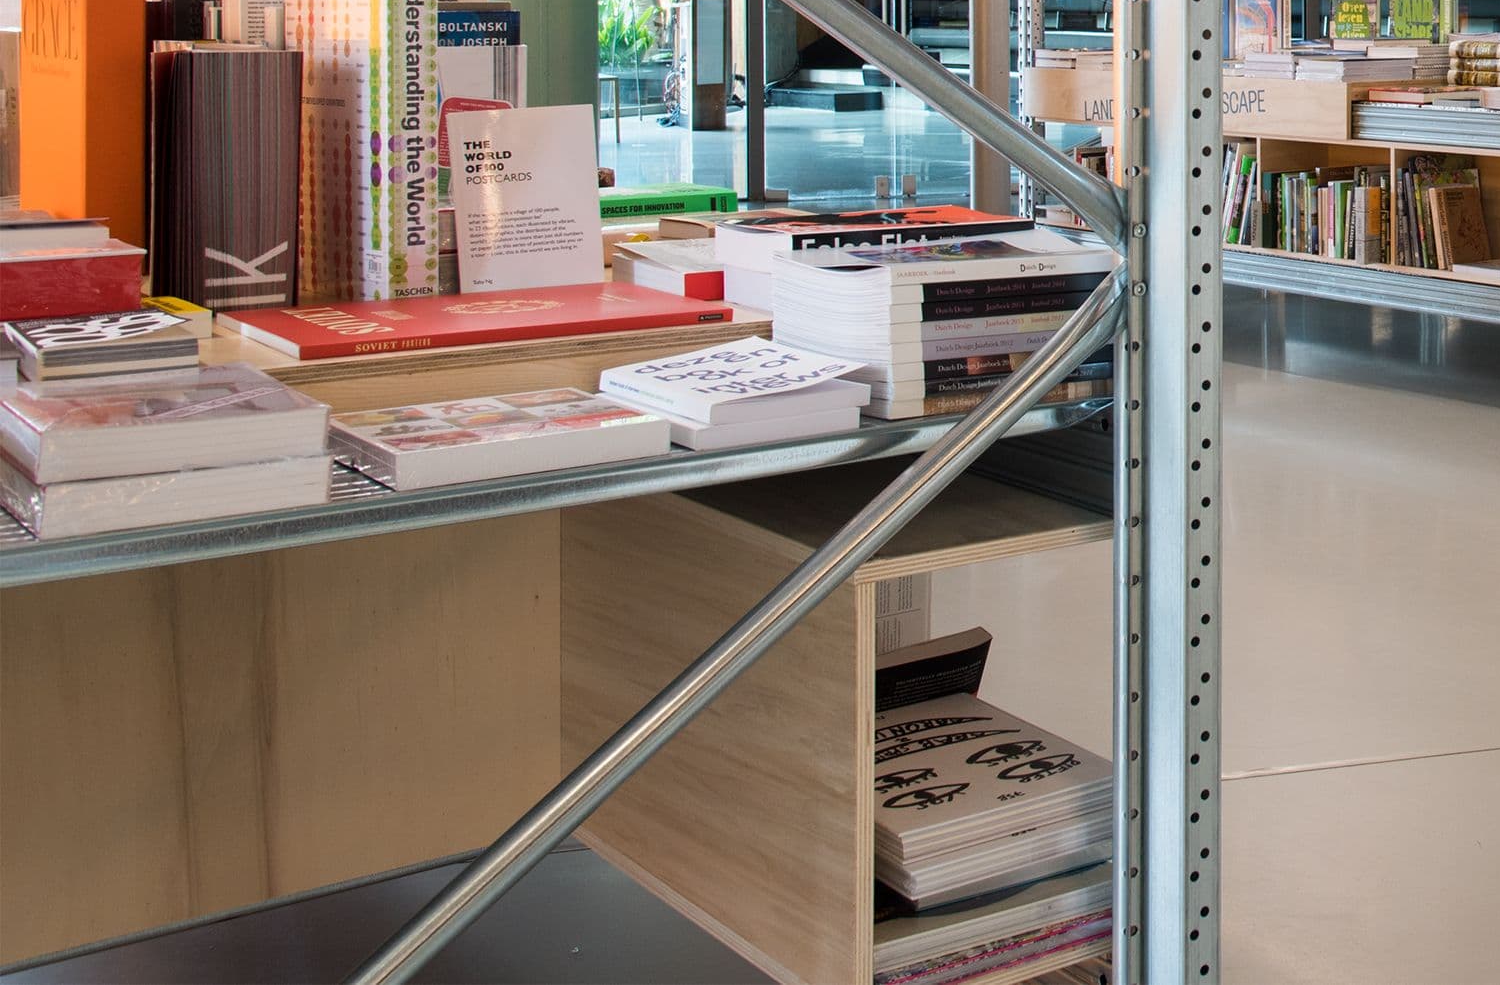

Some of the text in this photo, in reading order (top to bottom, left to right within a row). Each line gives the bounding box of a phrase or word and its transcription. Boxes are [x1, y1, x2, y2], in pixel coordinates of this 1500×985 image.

[438, 22, 508, 32] BOLTANSKI
[463, 140, 490, 151] THE
[406, 136, 426, 174] the
[464, 150, 512, 162] WORLD
[465, 164, 482, 173] OF
[466, 171, 533, 185] POSTCARDS
[406, 177, 426, 247] World
[601, 202, 685, 215] SPACES FOR INNOVATION
[1020, 263, 1037, 272] Dutch
[1038, 262, 1057, 271] Design
[394, 286, 434, 297] TASCHEN
[936, 286, 952, 296] Dutch
[953, 285, 976, 296] Design
[935, 305, 952, 315] Dutch
[953, 304, 974, 314] Design
[935, 323, 951, 332] Dutch
[952, 322, 974, 332] Design
[354, 340, 397, 353] SOVIET
[935, 343, 952, 353] Dutch
[953, 342, 975, 352] Design
[974, 340, 999, 350] Jaarboek
[634, 347, 778, 376] dezeen
[652, 354, 801, 383] book of
[937, 363, 954, 373] Dutch
[955, 363, 976, 372] Design
[938, 382, 977, 392] Dutch Design
